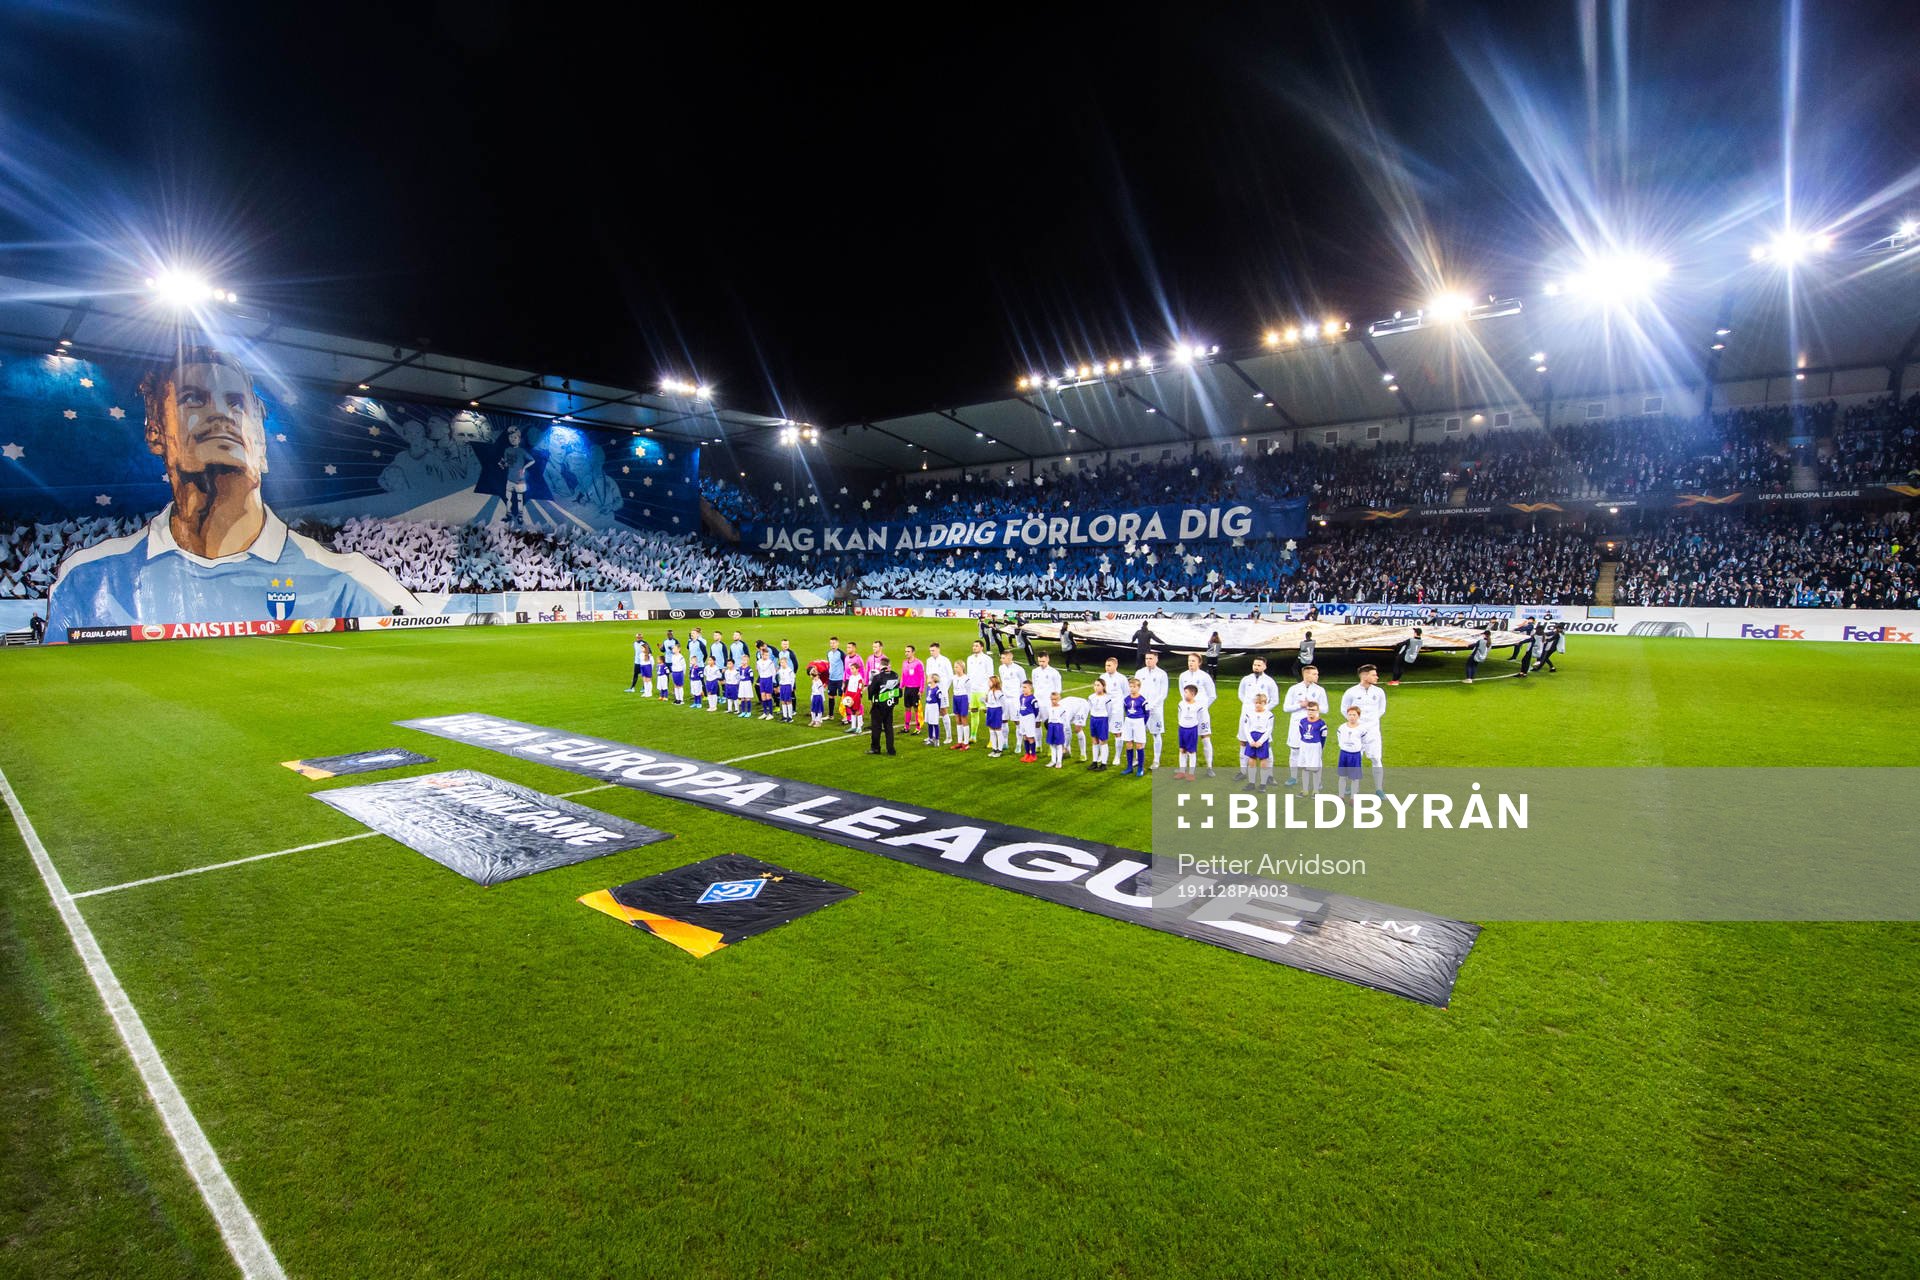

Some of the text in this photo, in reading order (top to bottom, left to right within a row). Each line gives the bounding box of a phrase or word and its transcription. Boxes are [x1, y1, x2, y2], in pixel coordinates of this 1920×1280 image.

[1758, 490, 1860, 501] UEFA EUROPA LEAGUE
[758, 504, 1252, 552] JAG KAN ALDRIG FÖRLORA DIG
[538, 610, 567, 622] FedEx
[613, 609, 639, 620] FedEx
[761, 608, 809, 617] enterprise
[864, 607, 897, 617] AMSTEL
[935, 608, 957, 617] FedEx
[968, 609, 992, 618] FedEx
[105, 629, 128, 637] GAME
[171, 621, 257, 638] AMSTEL
[1741, 623, 1805, 639] FedEx
[1843, 625, 1914, 643] FedEx
[420, 713, 549, 747] UEFA
[520, 737, 780, 806] EUROPA
[767, 795, 1324, 944] LEAGUE
[504, 810, 625, 846] GAME
